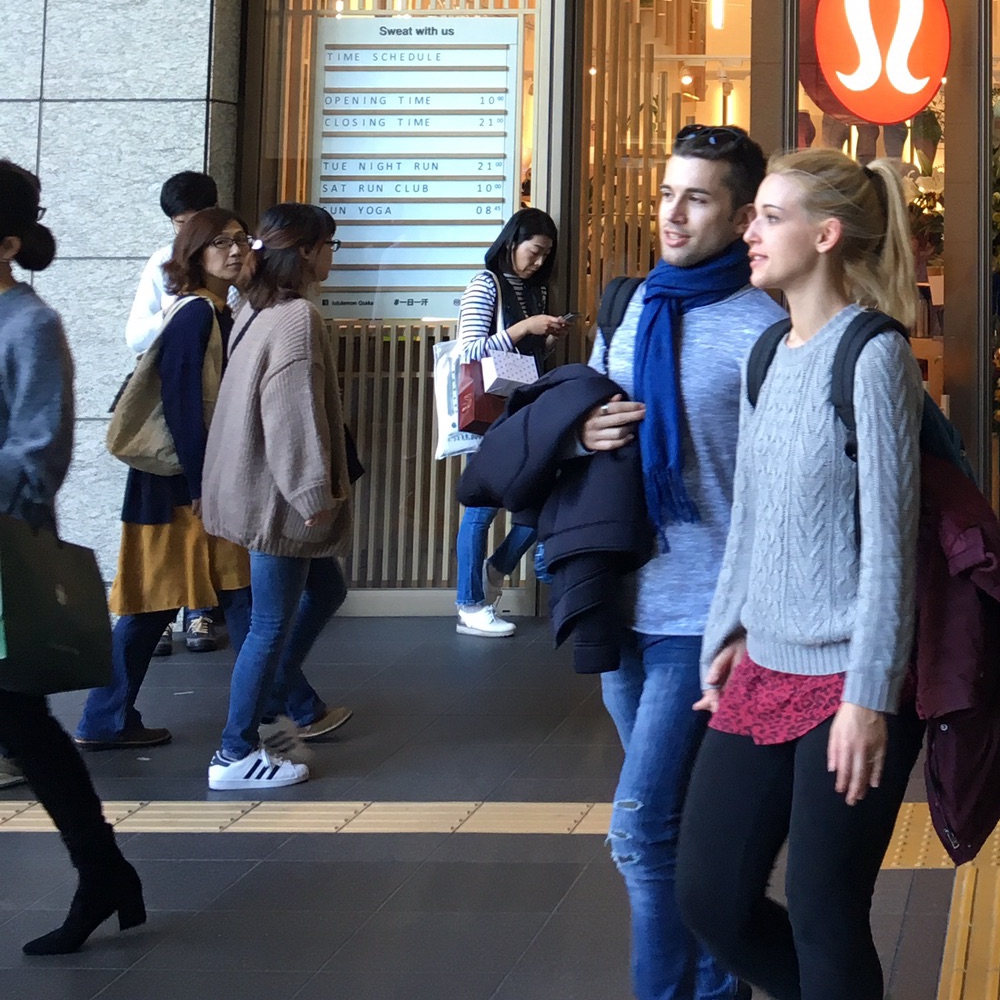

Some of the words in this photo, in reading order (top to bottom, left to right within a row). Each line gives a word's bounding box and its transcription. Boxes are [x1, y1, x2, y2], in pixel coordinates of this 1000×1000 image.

[379, 26, 413, 36] Sweat
[415, 26, 439, 36] with
[441, 27, 455, 36] us
[327, 53, 361, 62] TIME
[373, 53, 442, 62] SCHEDULE
[324, 96, 387, 105] OPENING
[398, 96, 431, 105] TIME
[324, 118, 386, 127] CLOSING
[398, 118, 431, 127] TIME
[323, 162, 347, 171] TUE
[359, 162, 402, 171] NIGHT
[414, 162, 439, 171] RUN
[322, 184, 347, 193] SAT
[358, 184, 384, 193] RUN
[395, 184, 429, 193] CLUB
[322, 206, 347, 215] UN
[358, 206, 392, 215] YOGA
